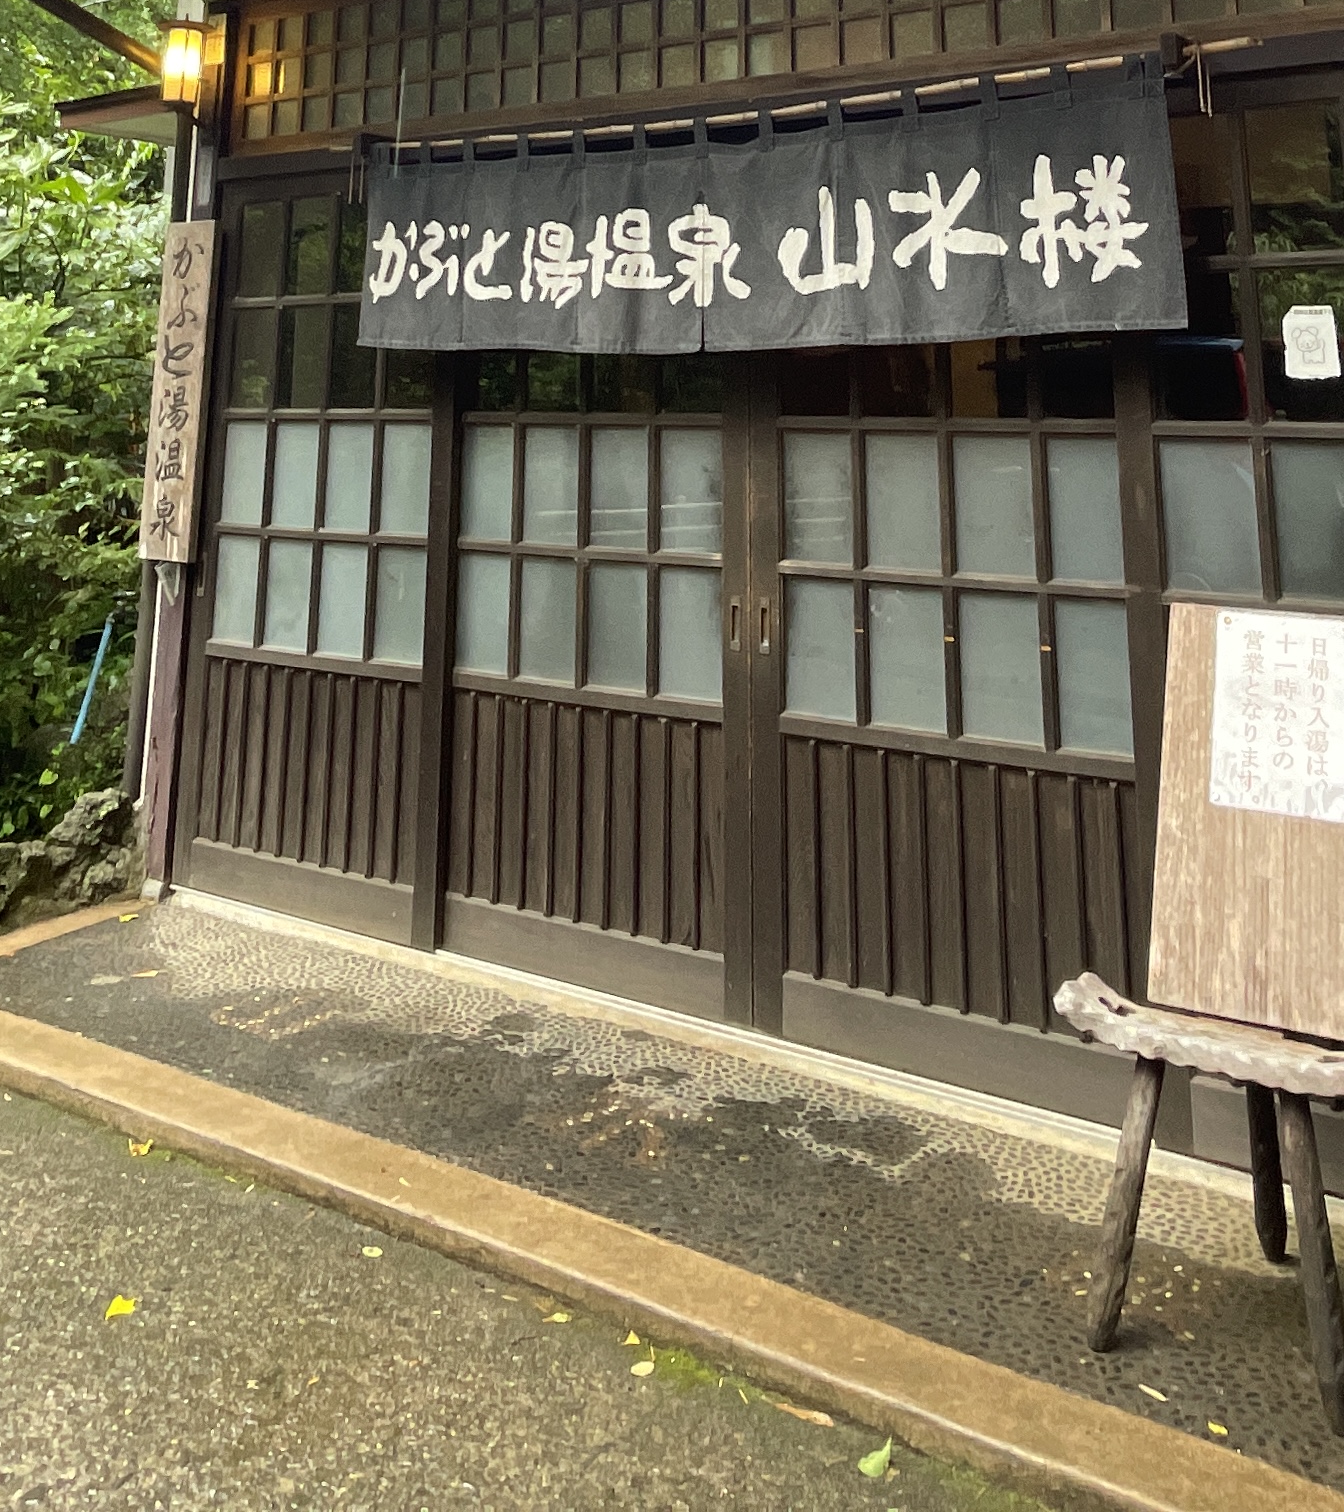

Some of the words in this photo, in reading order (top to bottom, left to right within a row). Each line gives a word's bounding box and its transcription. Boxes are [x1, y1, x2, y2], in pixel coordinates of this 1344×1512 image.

[368, 205, 752, 309] かぶと湯温泉
[779, 154, 1149, 297] 山水楼
[150, 241, 205, 539] かぶと湯温泉
[1238, 630, 1265, 803] 営業となります。
[1272, 633, 1298, 771] 十一時からの
